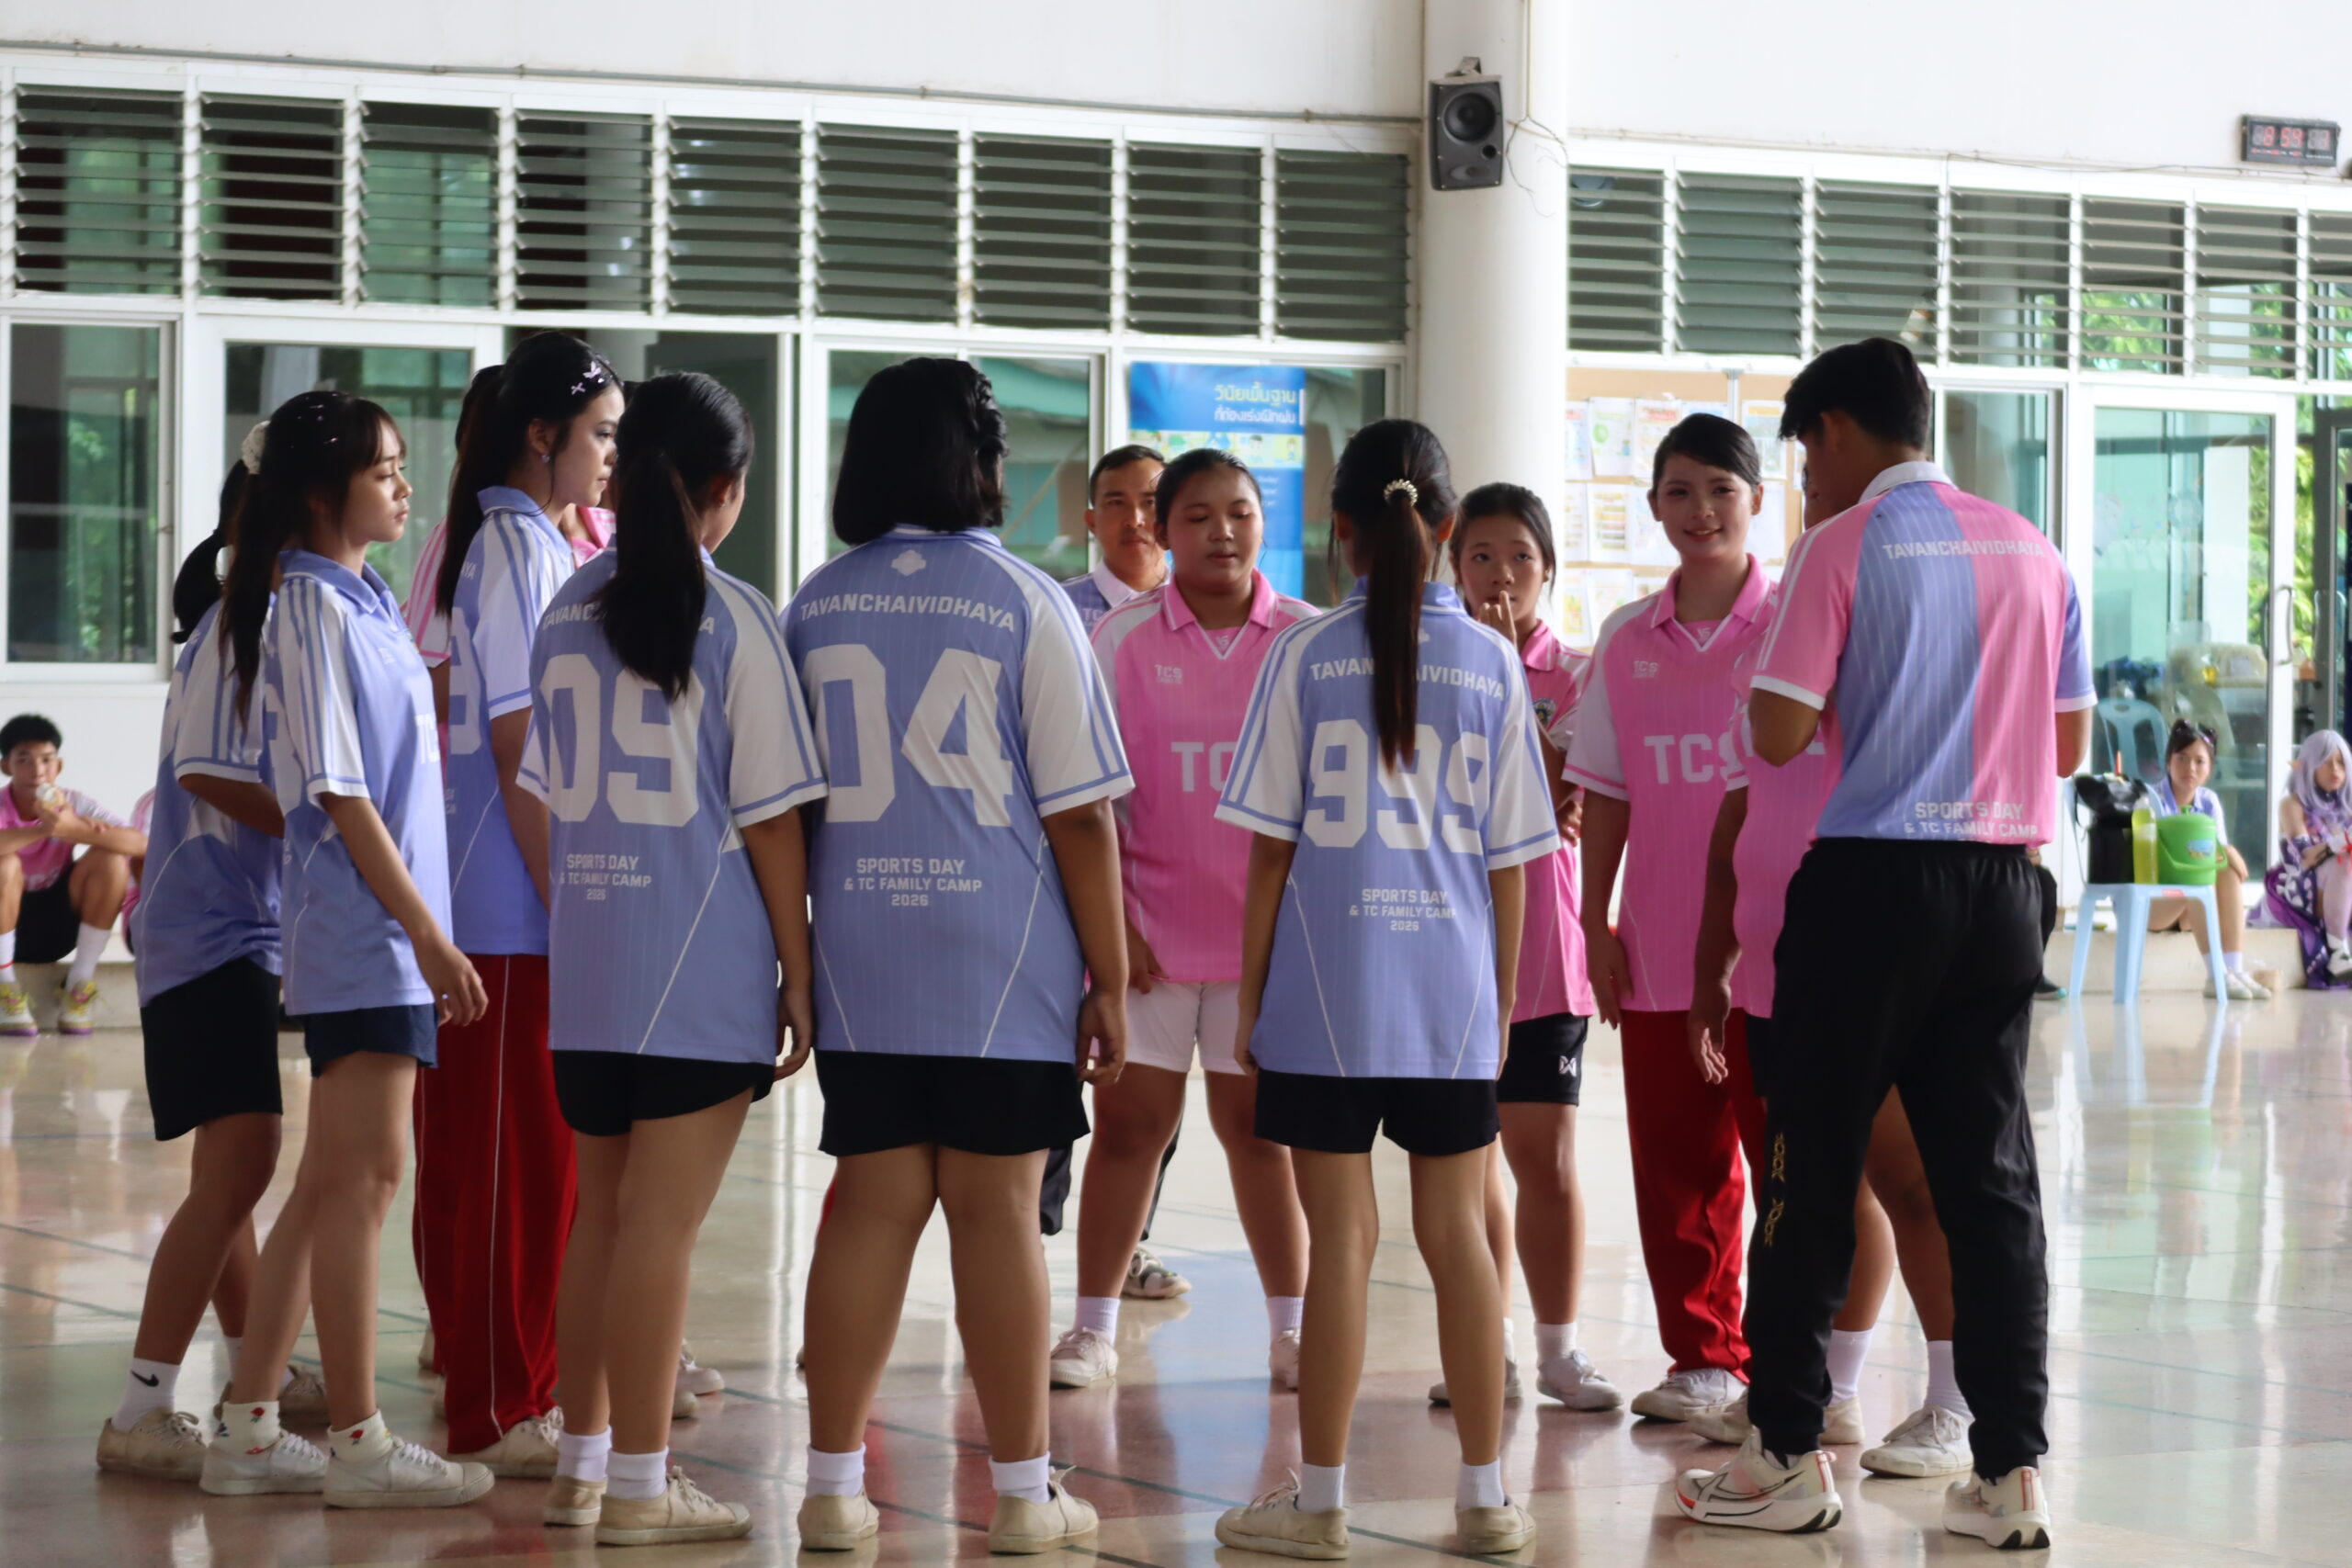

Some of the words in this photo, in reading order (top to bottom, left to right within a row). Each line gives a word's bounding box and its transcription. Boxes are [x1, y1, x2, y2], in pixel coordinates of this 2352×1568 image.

[1883, 540, 2044, 559] TAVANCHAIVIDHAYA
[800, 593, 1015, 632] TAVANCHAIVIDHAYA
[1155, 663, 1182, 678] TCS
[1310, 658, 1505, 701] TAVANIVIDHAYA
[539, 653, 706, 827] 09
[801, 644, 1013, 827] 04
[1303, 719, 1490, 855] 999
[1915, 801, 1988, 818] SPORTS
[1993, 801, 2024, 819] DAY
[1904, 822, 1916, 834] &
[1919, 822, 1939, 833] TC
[1943, 822, 1995, 836] FAMILY
[1998, 823, 2039, 838] CAMP
[567, 853, 605, 870] SPORTS
[608, 854, 639, 871] DAY
[856, 857, 923, 874] SPORTS
[929, 859, 966, 874] DAY
[612, 874, 652, 887] CAMP
[843, 878, 854, 891] &
[858, 877, 875, 891] TC
[879, 877, 933, 891] FAMILY
[936, 878, 983, 893] CAMP
[891, 894, 929, 907] 2026
[1362, 888, 1417, 903] SPORTS
[1420, 890, 1449, 904] DAY
[1349, 905, 1359, 916] &
[1363, 905, 1378, 917] TC
[1382, 906, 1423, 918] FAMILY
[1390, 920, 1419, 931] 2026
